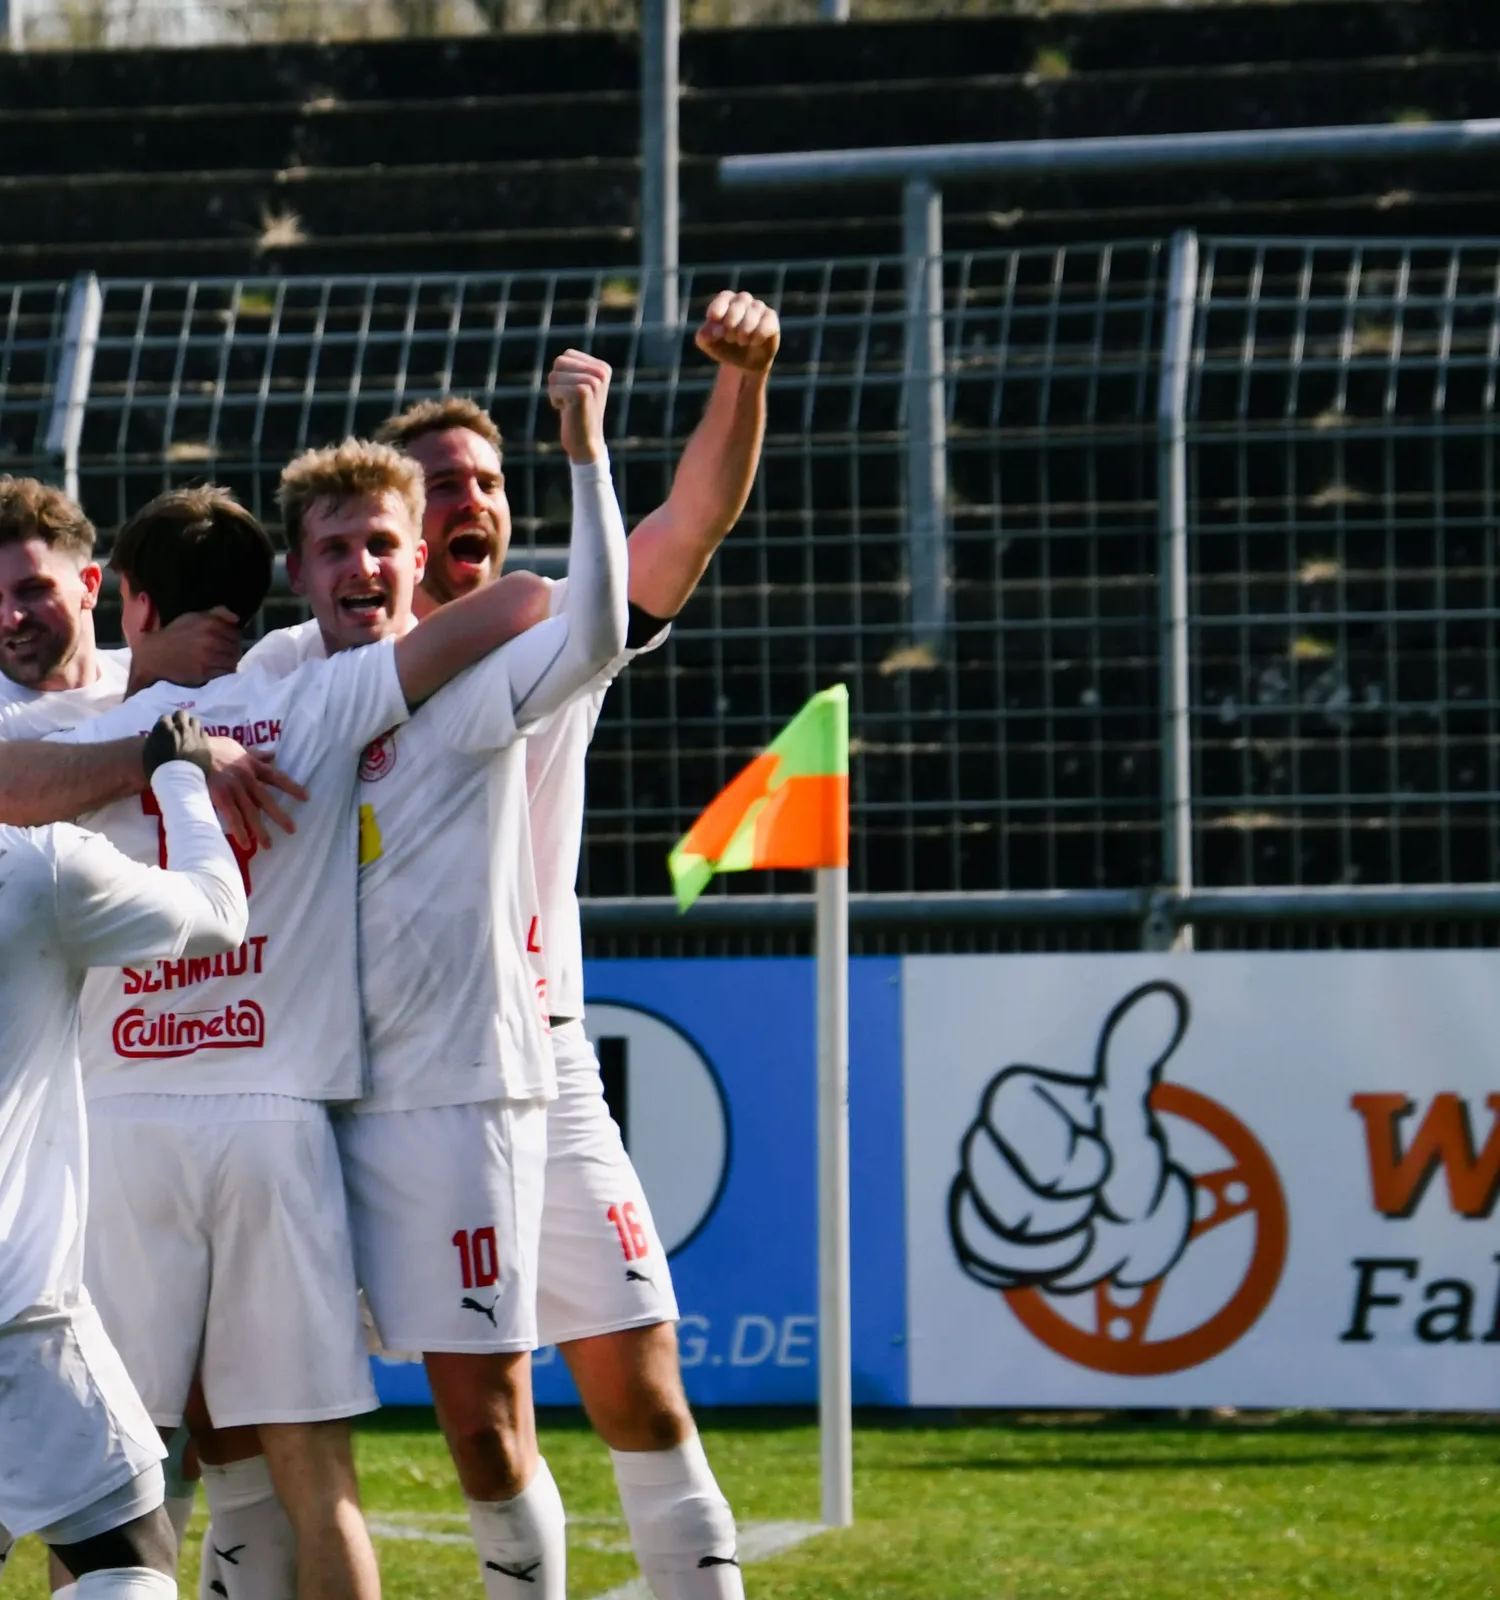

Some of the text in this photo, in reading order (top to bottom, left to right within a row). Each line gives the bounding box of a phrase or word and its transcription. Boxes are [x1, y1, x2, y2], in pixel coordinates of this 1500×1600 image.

[117, 1001, 261, 1052] Culimeta
[452, 1226, 500, 1290] 10
[606, 1200, 650, 1262] 16
[1338, 1252, 1500, 1345] Fa
